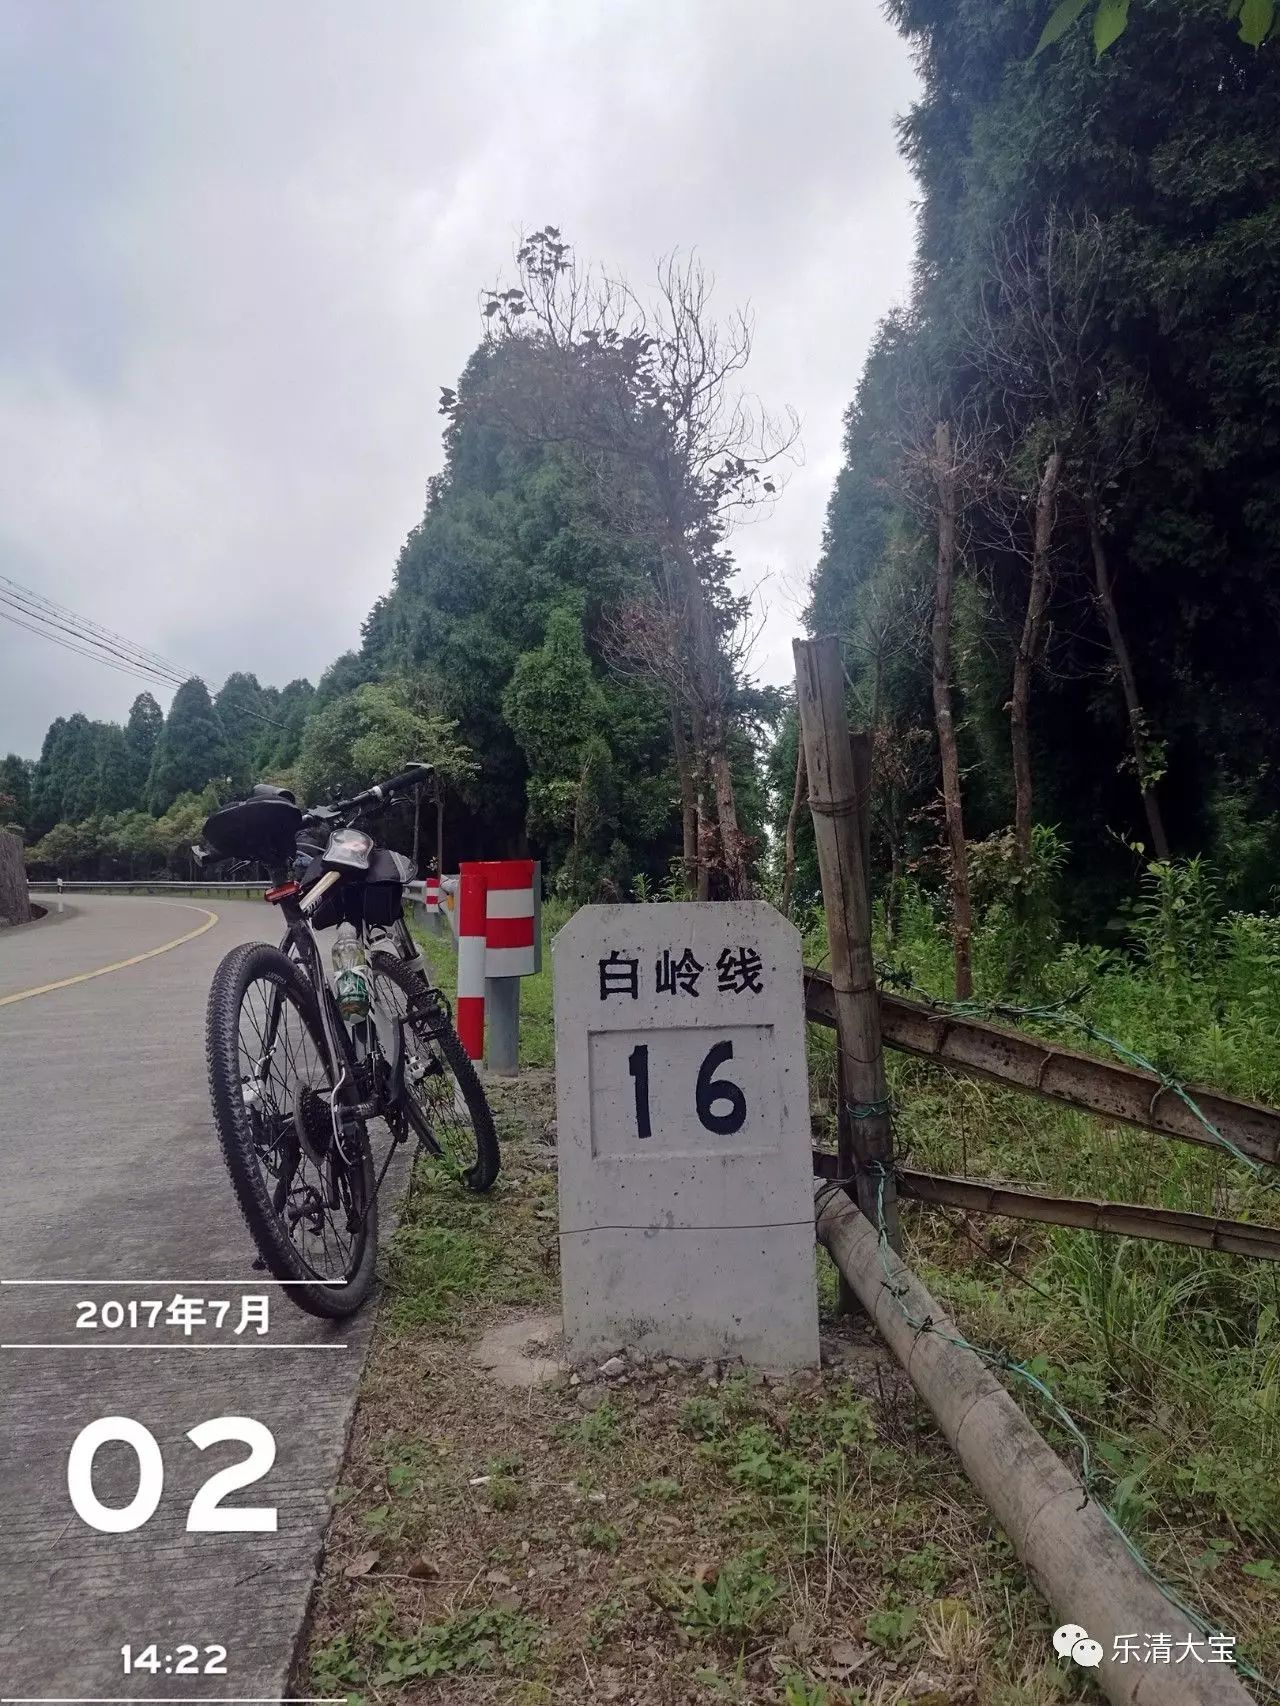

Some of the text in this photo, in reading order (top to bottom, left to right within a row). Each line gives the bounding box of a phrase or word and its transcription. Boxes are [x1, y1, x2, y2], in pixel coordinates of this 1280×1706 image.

[598, 947, 764, 1000] 白岭线
[628, 1040, 747, 1139] 16
